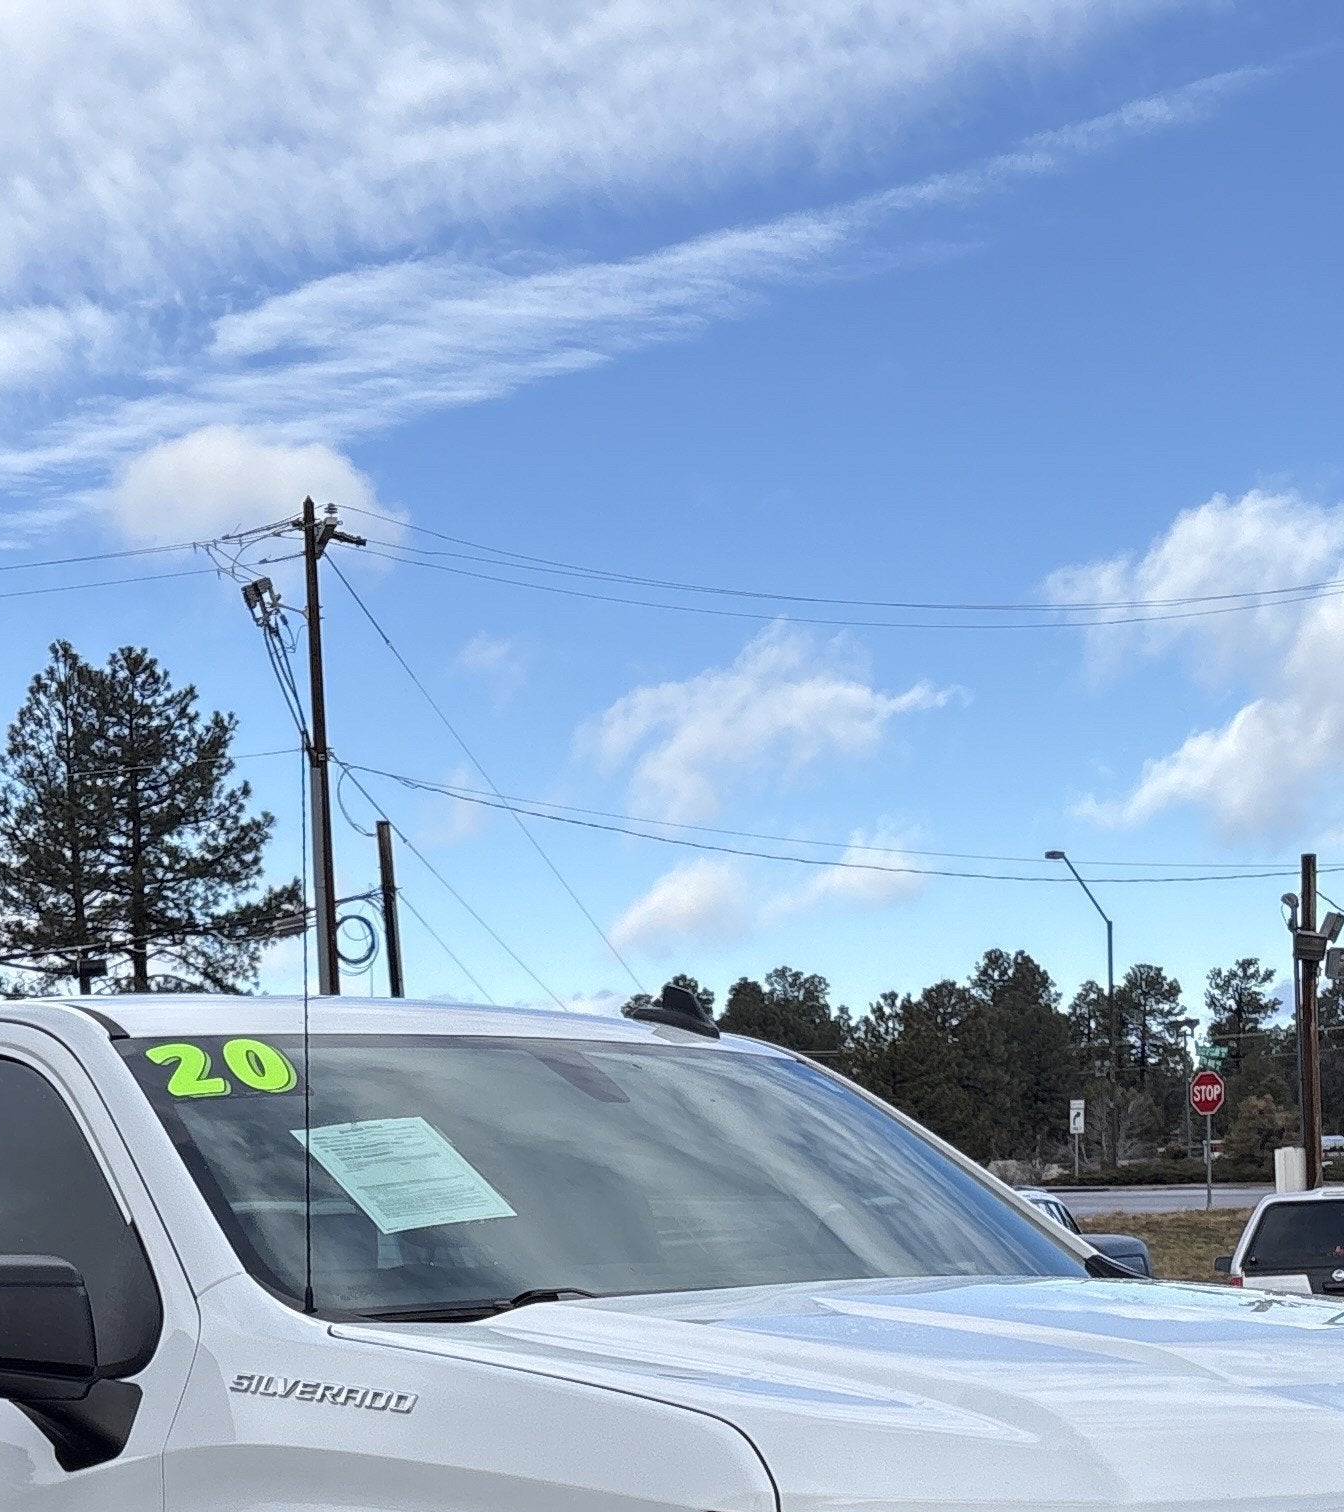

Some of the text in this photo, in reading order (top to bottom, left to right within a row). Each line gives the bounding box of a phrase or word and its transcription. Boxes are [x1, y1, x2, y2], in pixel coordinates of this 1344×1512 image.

[145, 1037, 298, 1099] 20
[1193, 1084, 1221, 1102] STOP
[229, 1371, 419, 1415] SILVERADO
